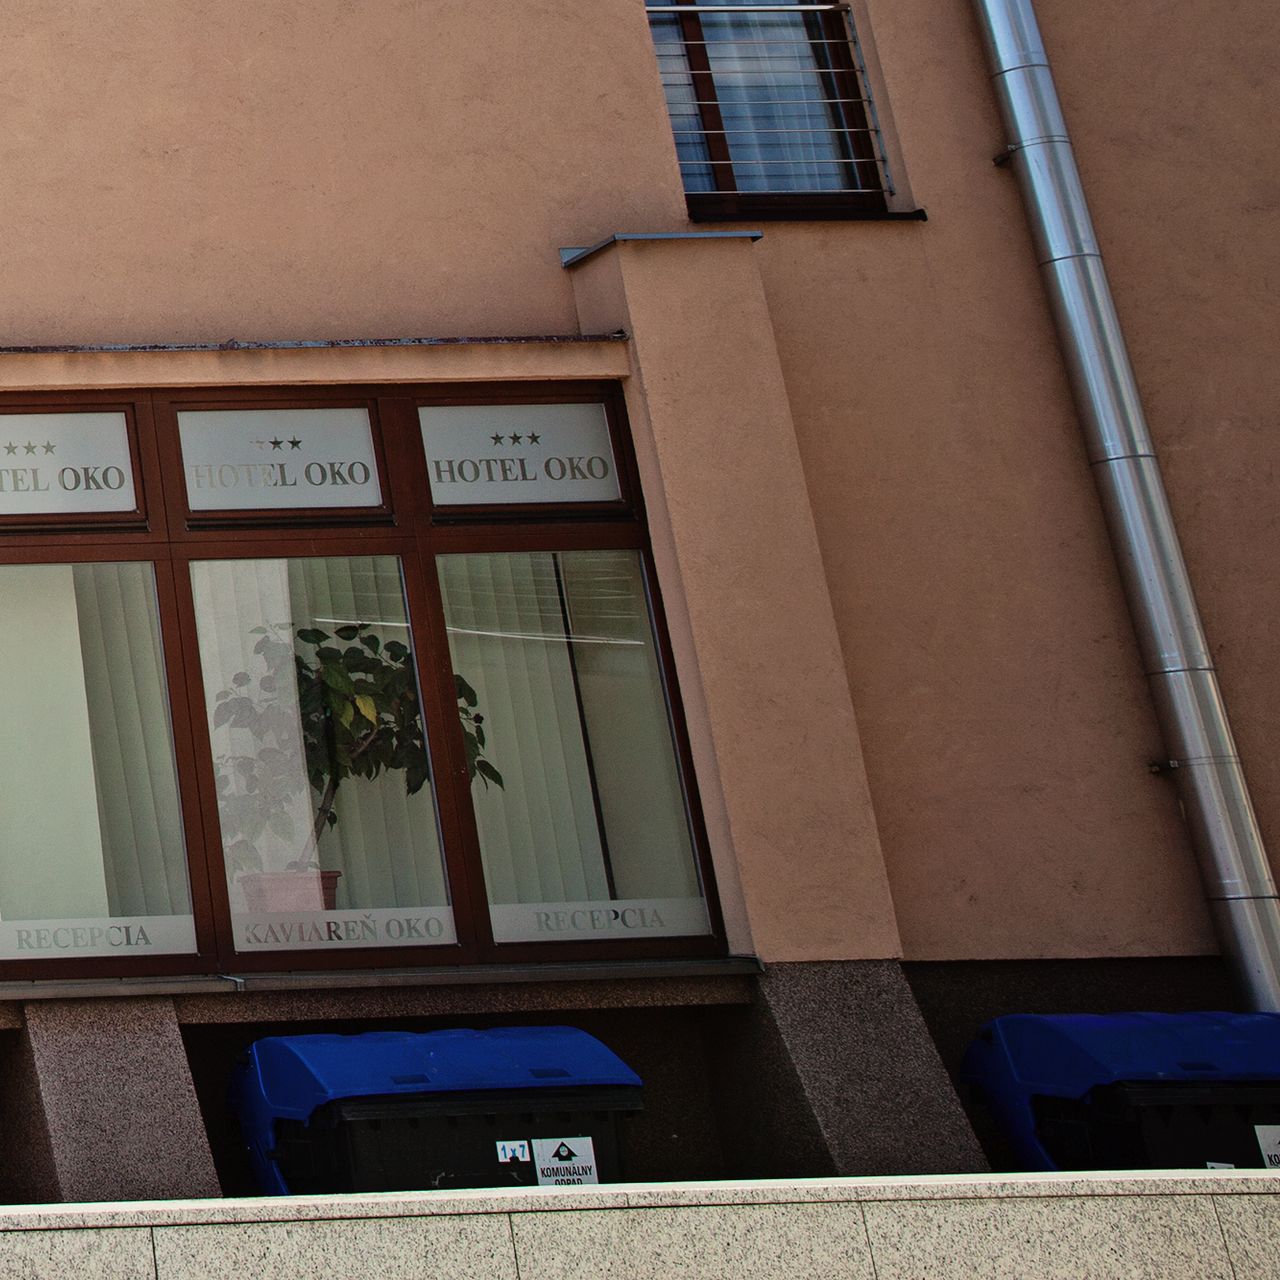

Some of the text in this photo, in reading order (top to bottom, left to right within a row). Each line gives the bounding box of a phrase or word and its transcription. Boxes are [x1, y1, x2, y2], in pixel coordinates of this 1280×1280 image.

[58, 466, 125, 491] OKO
[192, 462, 371, 489] HOTEL OKO
[430, 456, 609, 483] HOTEL OKO
[245, 913, 444, 945] KAVIAREŇ OKO
[535, 907, 666, 933] RECEPCIA
[16, 925, 152, 950] RECEPCIA
[540, 1163, 592, 1178] KOMUNÁLNY
